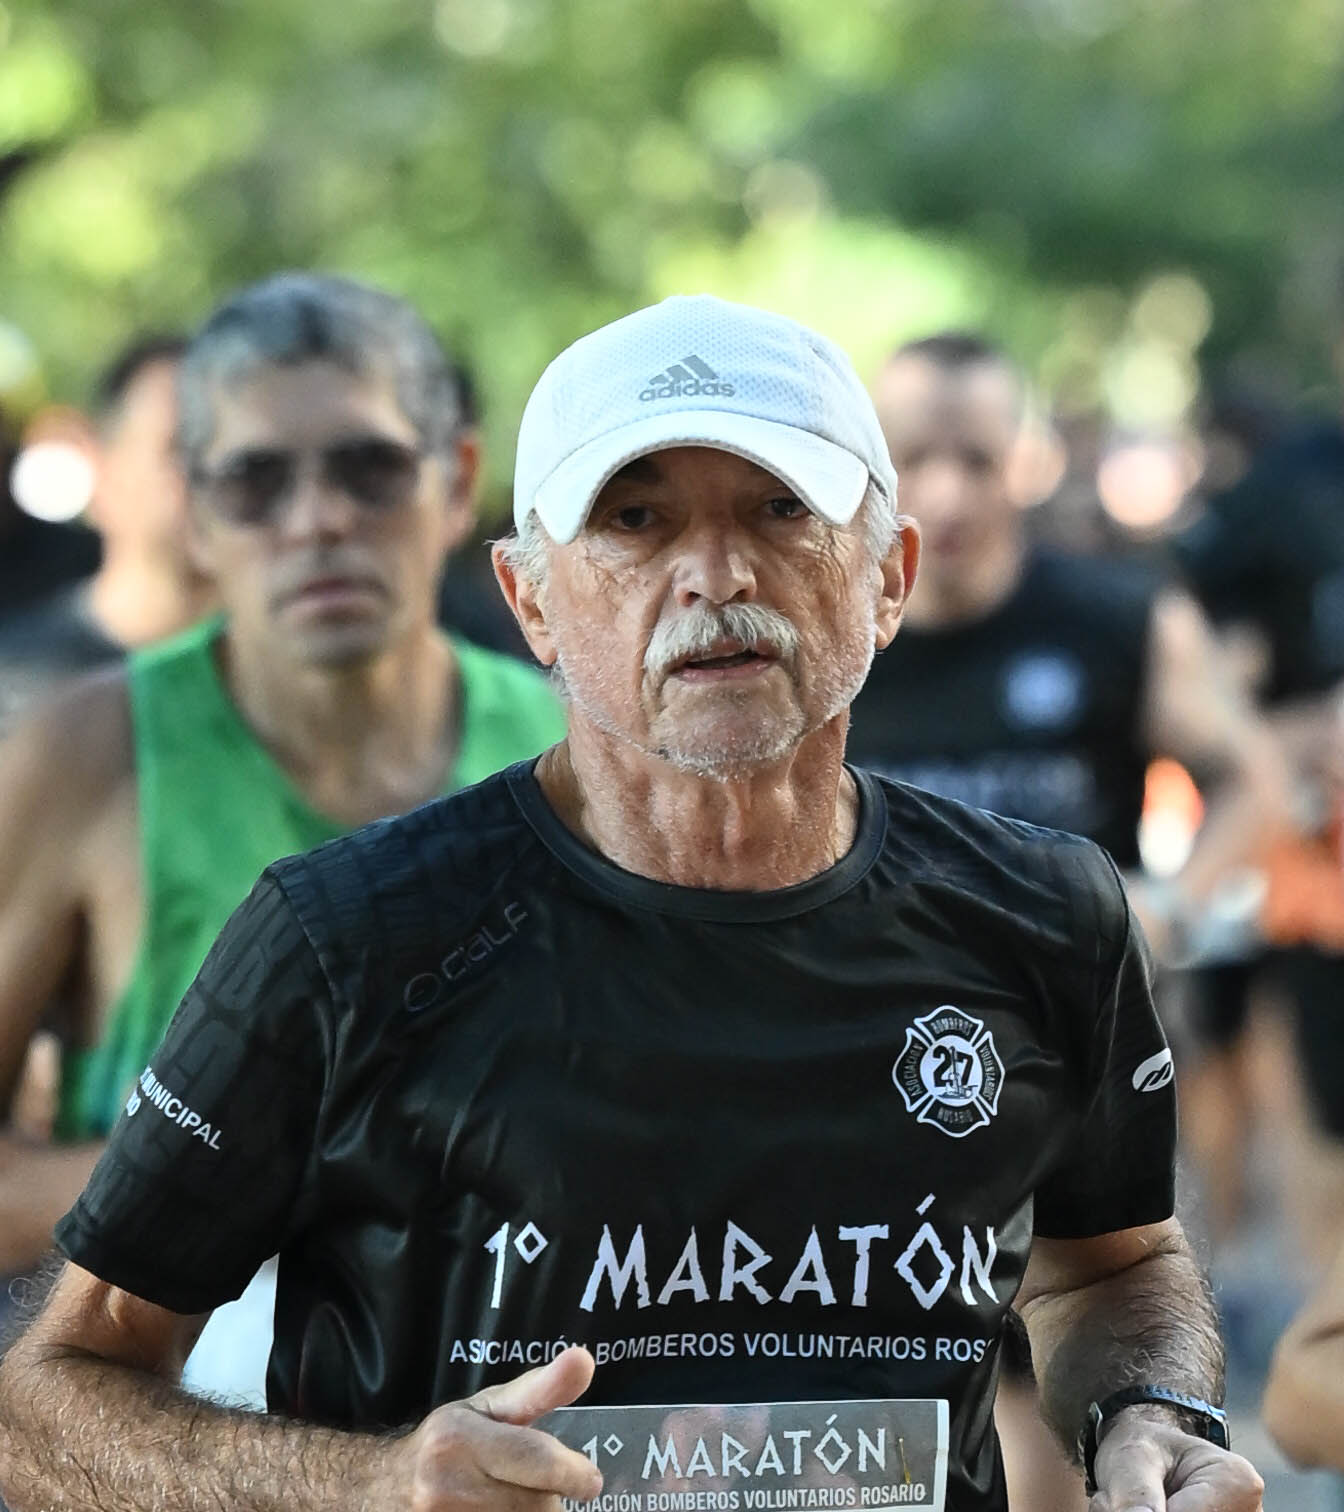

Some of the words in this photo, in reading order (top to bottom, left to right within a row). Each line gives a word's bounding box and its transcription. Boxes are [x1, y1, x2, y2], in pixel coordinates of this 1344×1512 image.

[639, 378, 736, 402] adidas
[932, 1044, 974, 1088] 27
[579, 1193, 1000, 1311] MARATÓN
[449, 1335, 587, 1364] ASCIACIÓ
[595, 1333, 735, 1365] BOMBEROS
[744, 1332, 927, 1361] VOLUNTARIOS
[935, 1337, 994, 1363] ROS
[641, 1414, 886, 1480] MARATÓN
[647, 1490, 739, 1512] BOMBEROS
[744, 1488, 856, 1509] VOLUNTARIOS
[861, 1483, 926, 1505] ROSARIO
